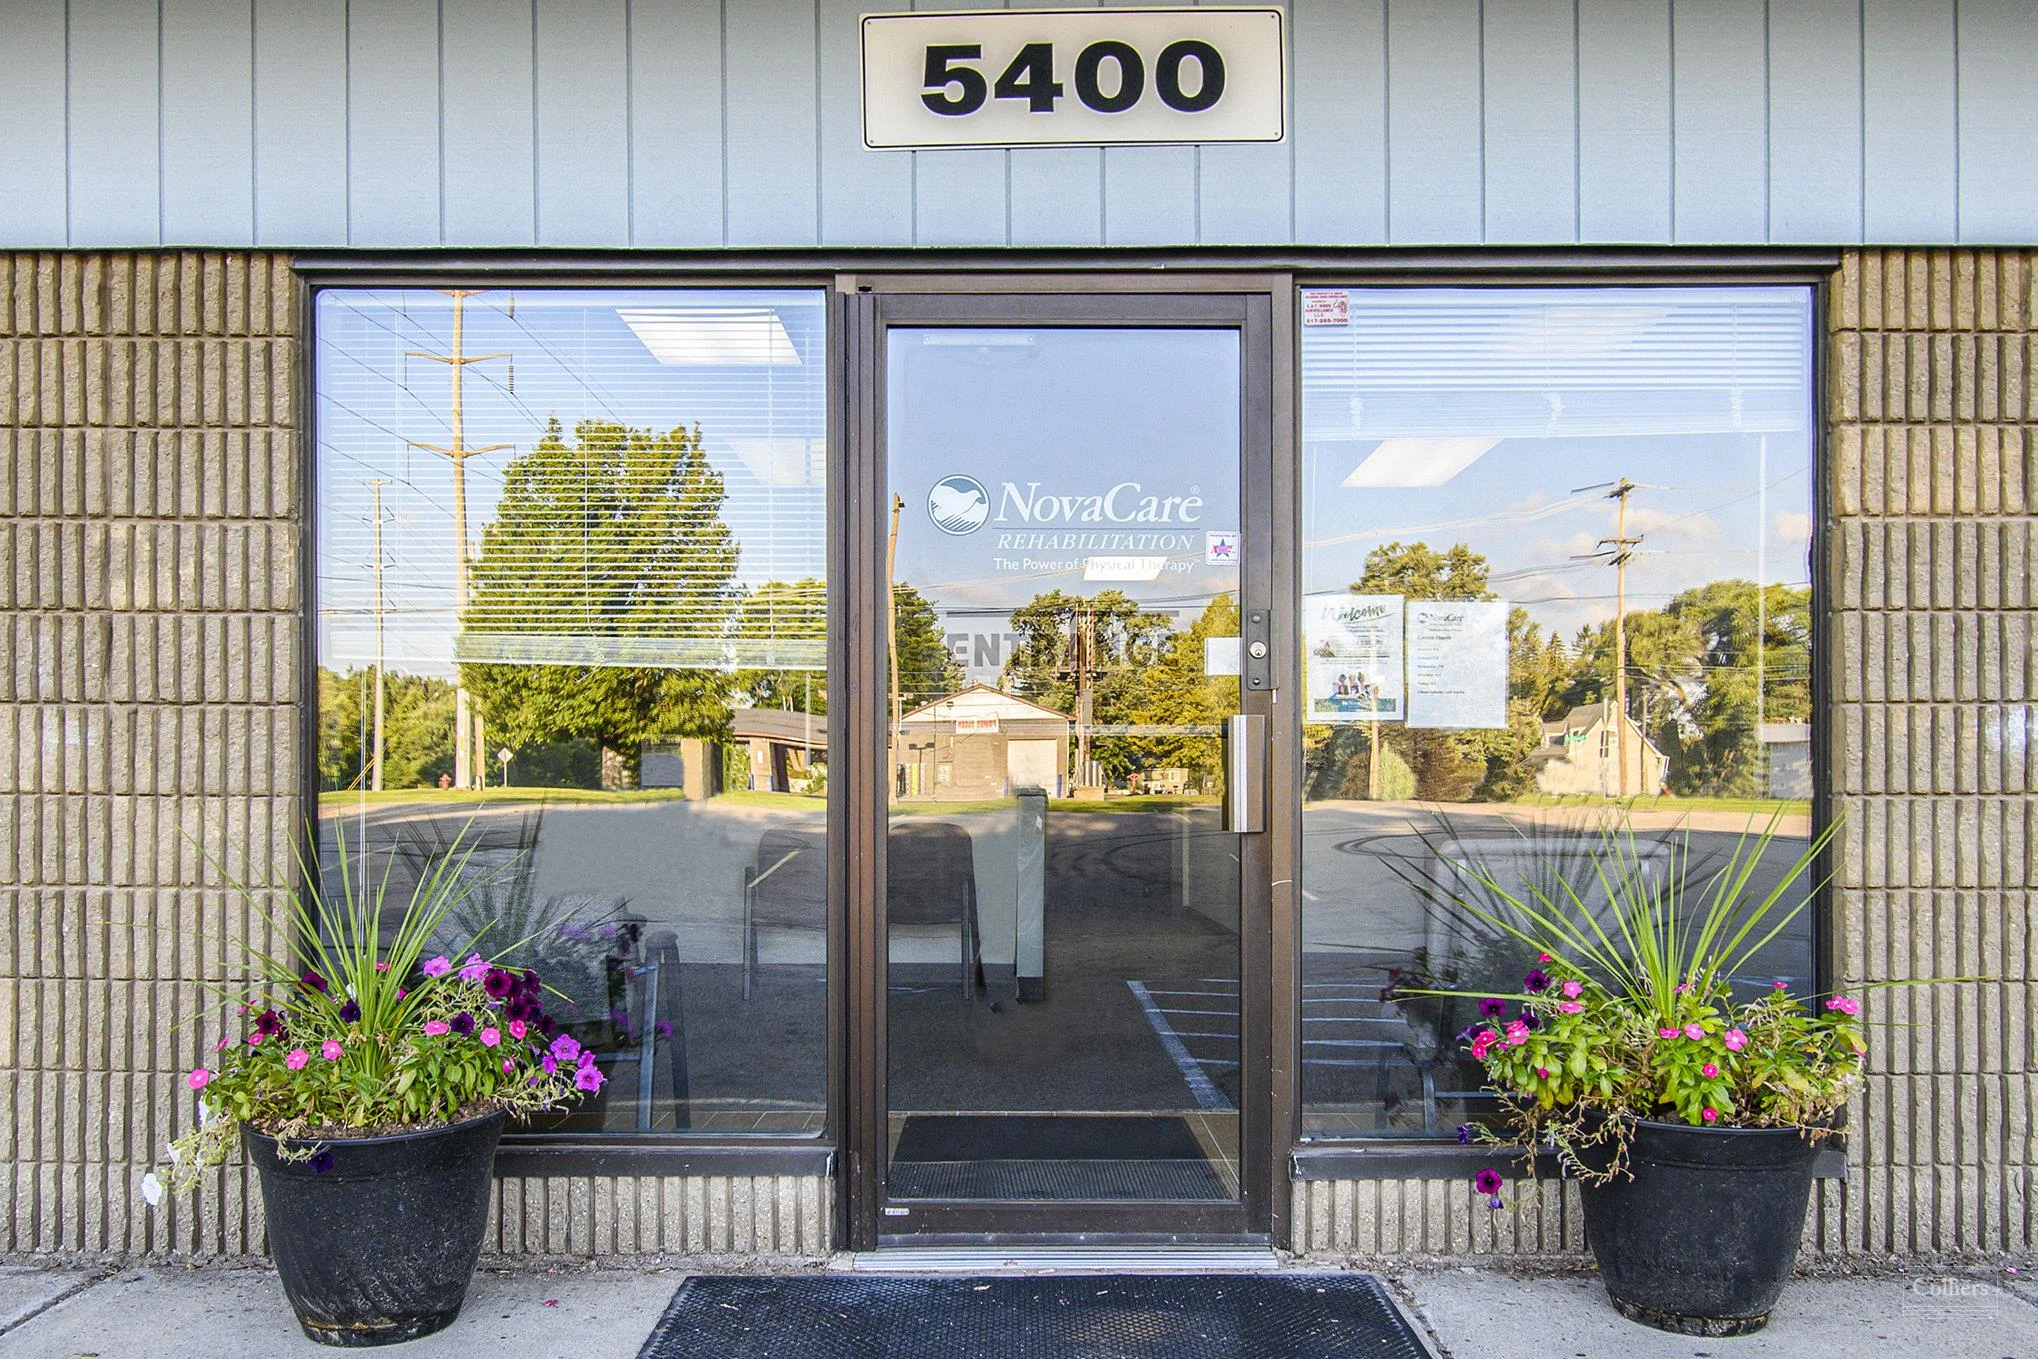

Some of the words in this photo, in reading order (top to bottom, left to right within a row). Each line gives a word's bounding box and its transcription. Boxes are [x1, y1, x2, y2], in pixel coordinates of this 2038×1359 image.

[921, 39, 1226, 117] 5400
[993, 482, 1204, 523] NovaCare
[996, 534, 1195, 550] REHABILITATION
[993, 558, 1019, 570] The
[1023, 558, 1063, 570] Power
[1065, 557, 1079, 570] of
[1083, 557, 1136, 573] Physical
[1140, 558, 1195, 574] Therapy
[1321, 603, 1387, 622] Welcome
